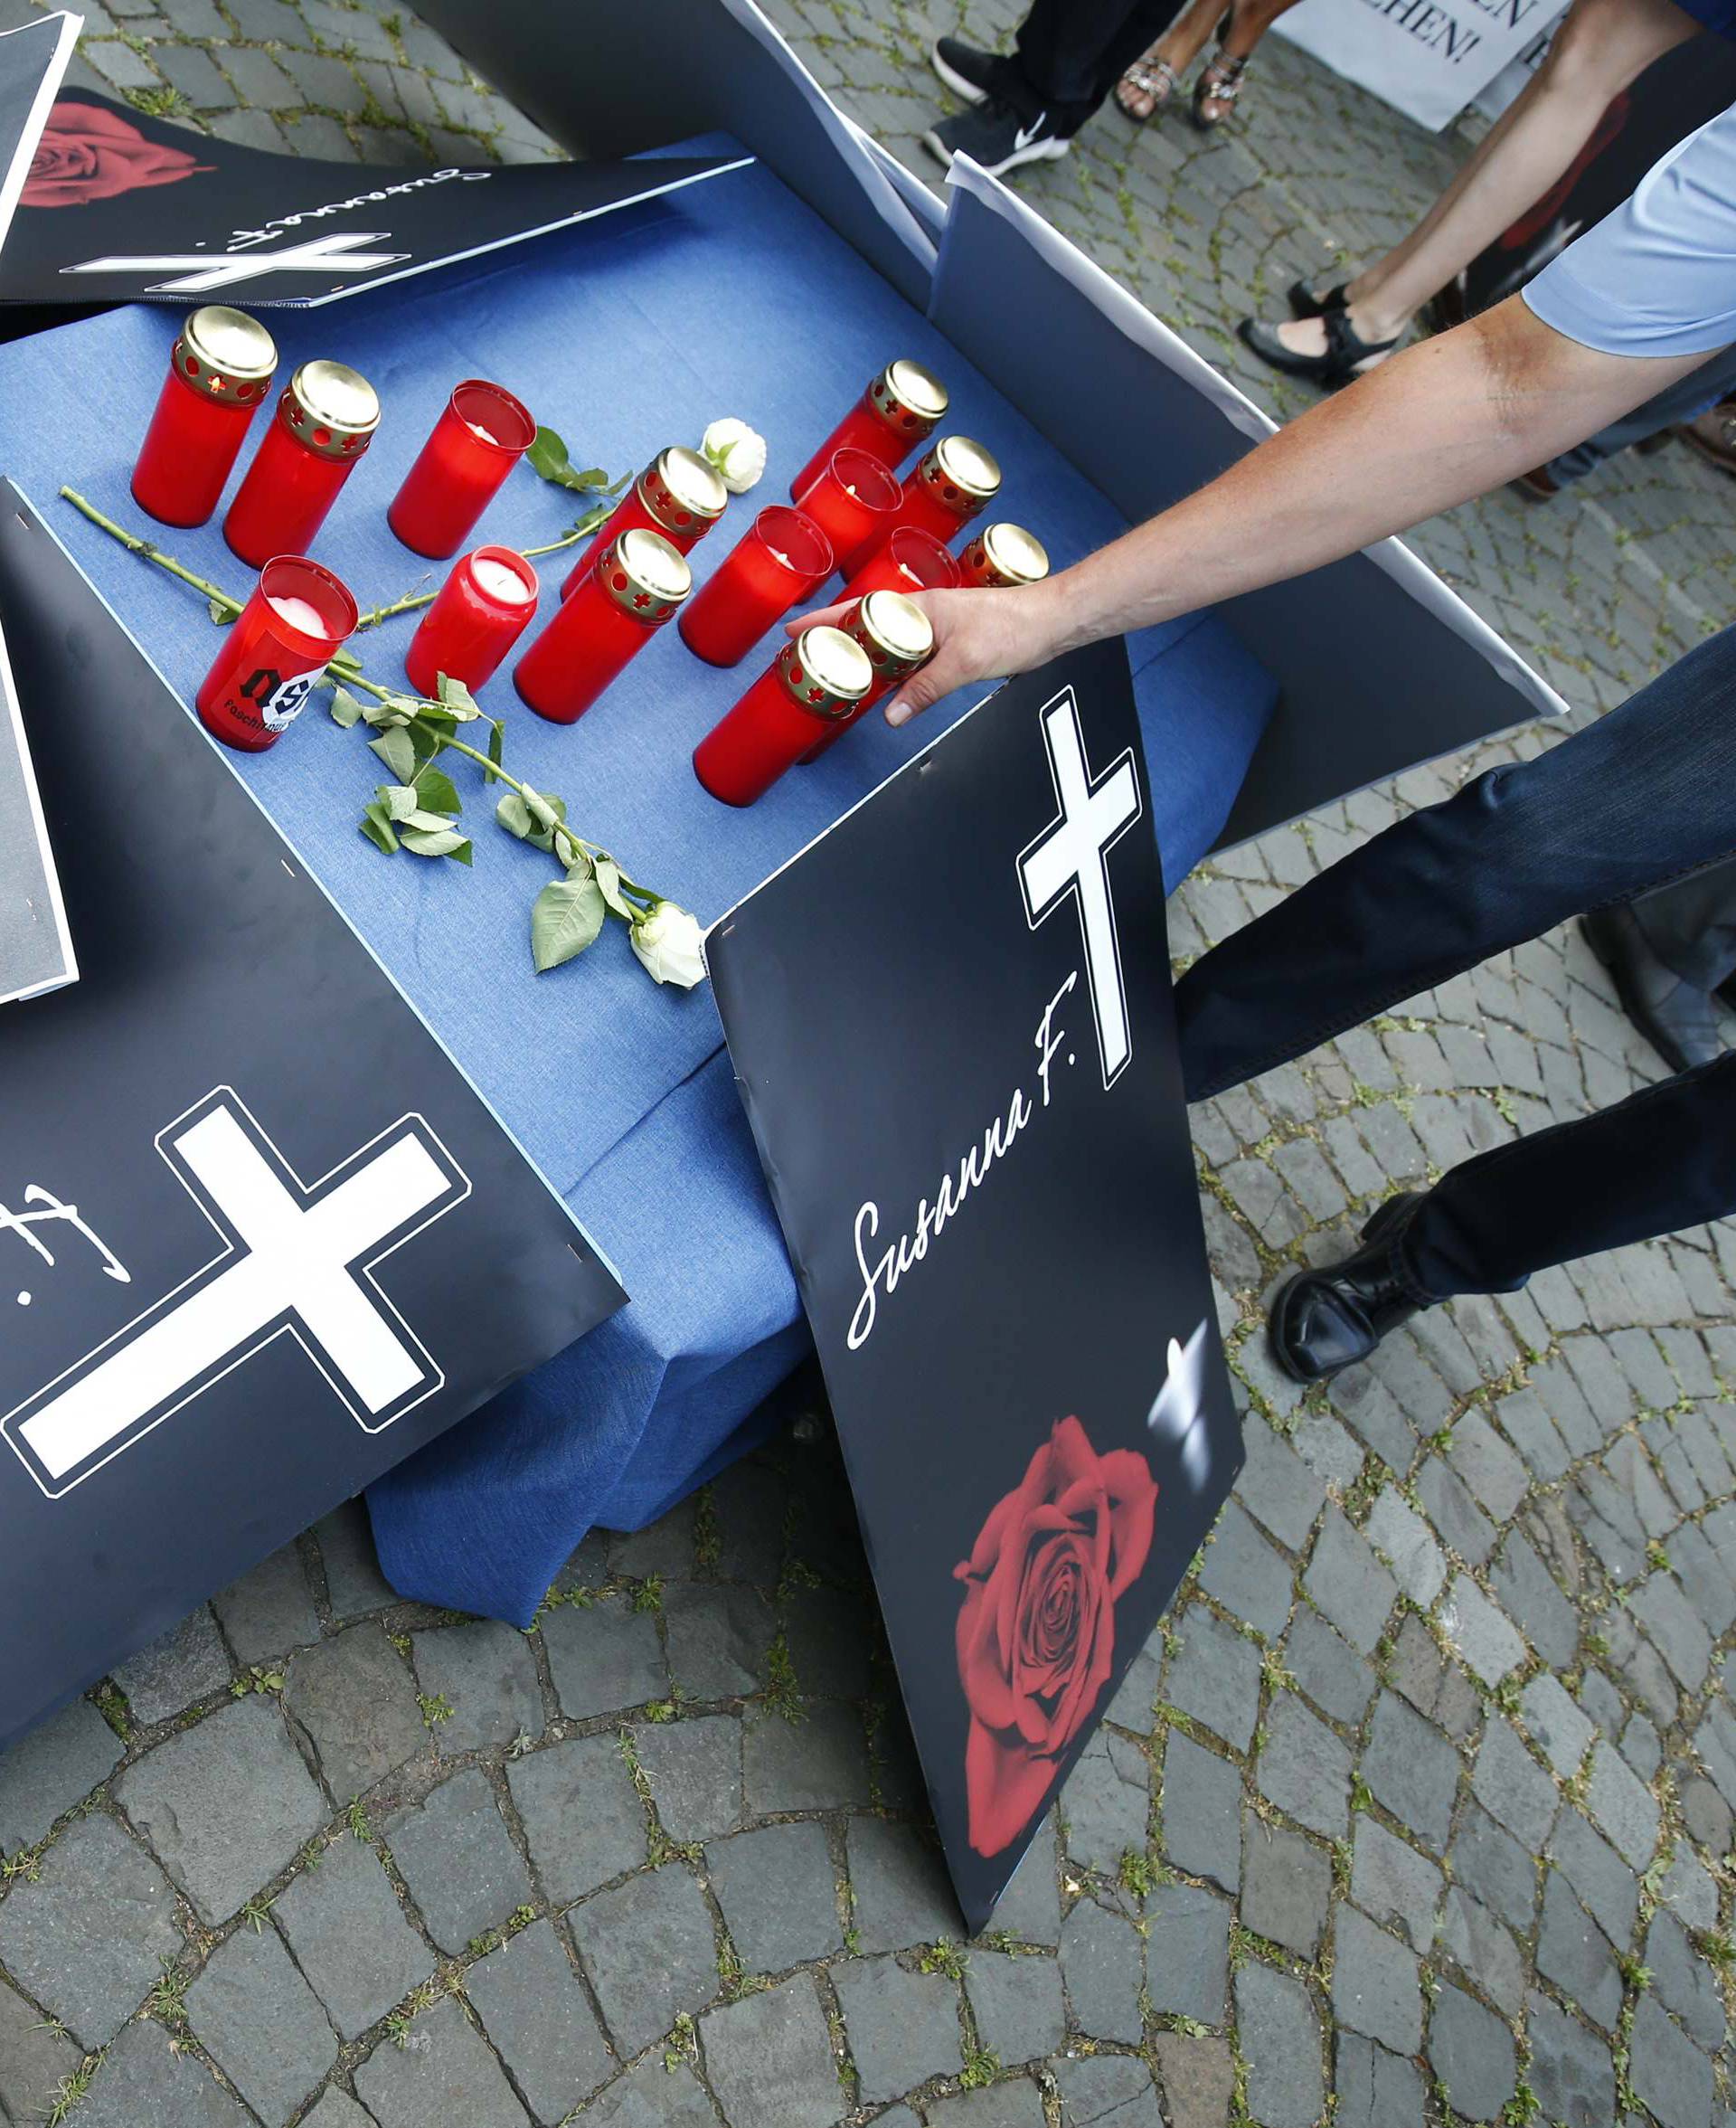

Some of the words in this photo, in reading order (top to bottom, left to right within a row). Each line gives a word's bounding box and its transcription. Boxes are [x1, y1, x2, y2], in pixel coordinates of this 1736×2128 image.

[1362, 0, 1482, 63] HEN!
[265, 168, 492, 230] Susanna
[846, 1088, 1033, 1350] Susanna
[1034, 970, 1078, 1107] F.
